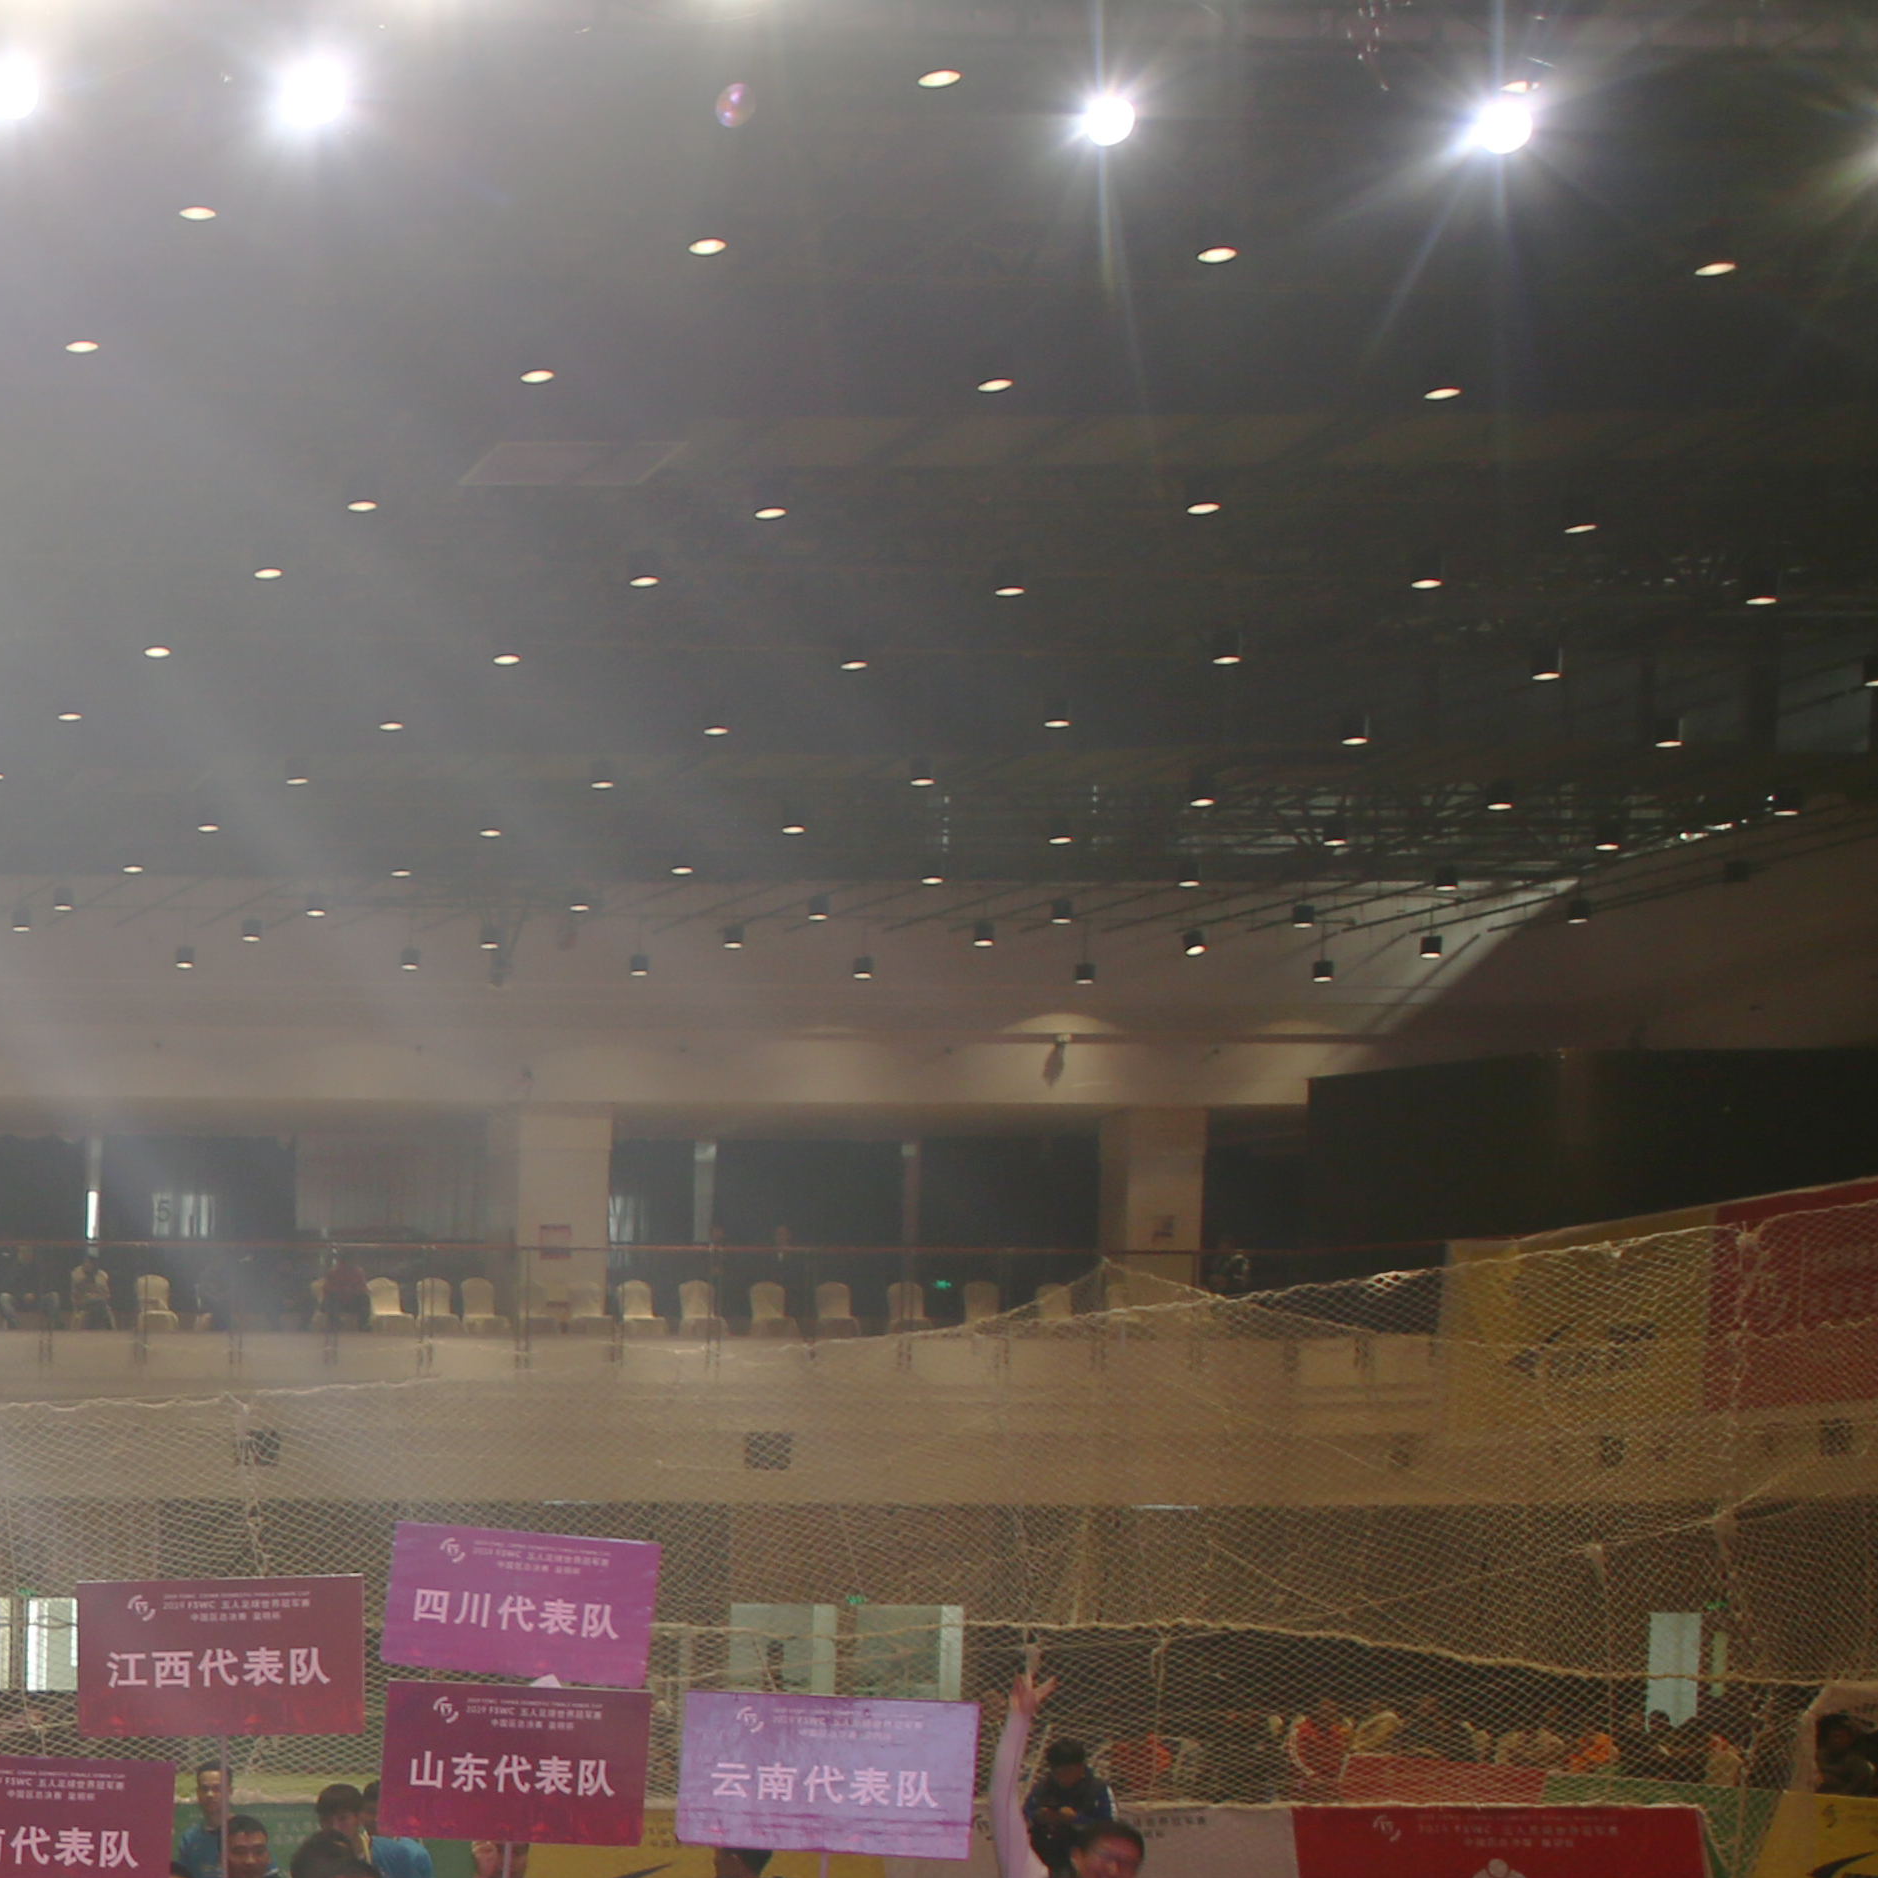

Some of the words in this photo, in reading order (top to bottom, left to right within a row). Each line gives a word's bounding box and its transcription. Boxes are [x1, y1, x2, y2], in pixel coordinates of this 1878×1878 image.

[413, 1588, 619, 1640] 四川代表队
[106, 1646, 331, 1689] 江西代表队
[409, 1750, 615, 1797] 山东代表队
[710, 1762, 939, 1808] 云南代表队
